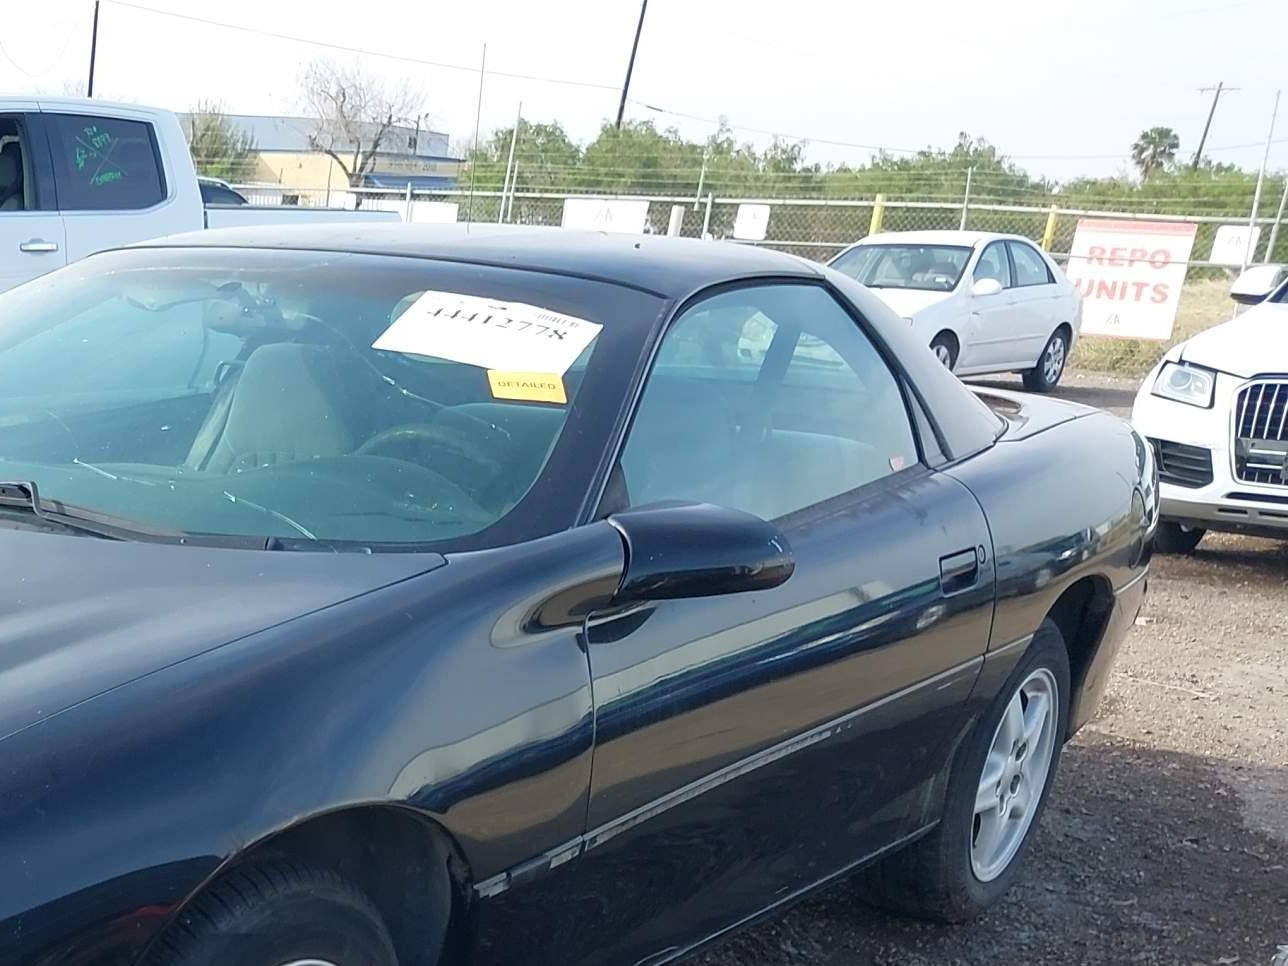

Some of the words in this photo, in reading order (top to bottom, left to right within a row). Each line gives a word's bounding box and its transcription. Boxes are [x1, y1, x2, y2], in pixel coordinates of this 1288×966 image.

[1086, 245, 1172, 270] REPO
[1075, 277, 1170, 304] UNITS
[497, 380, 556, 391] DETAILED
